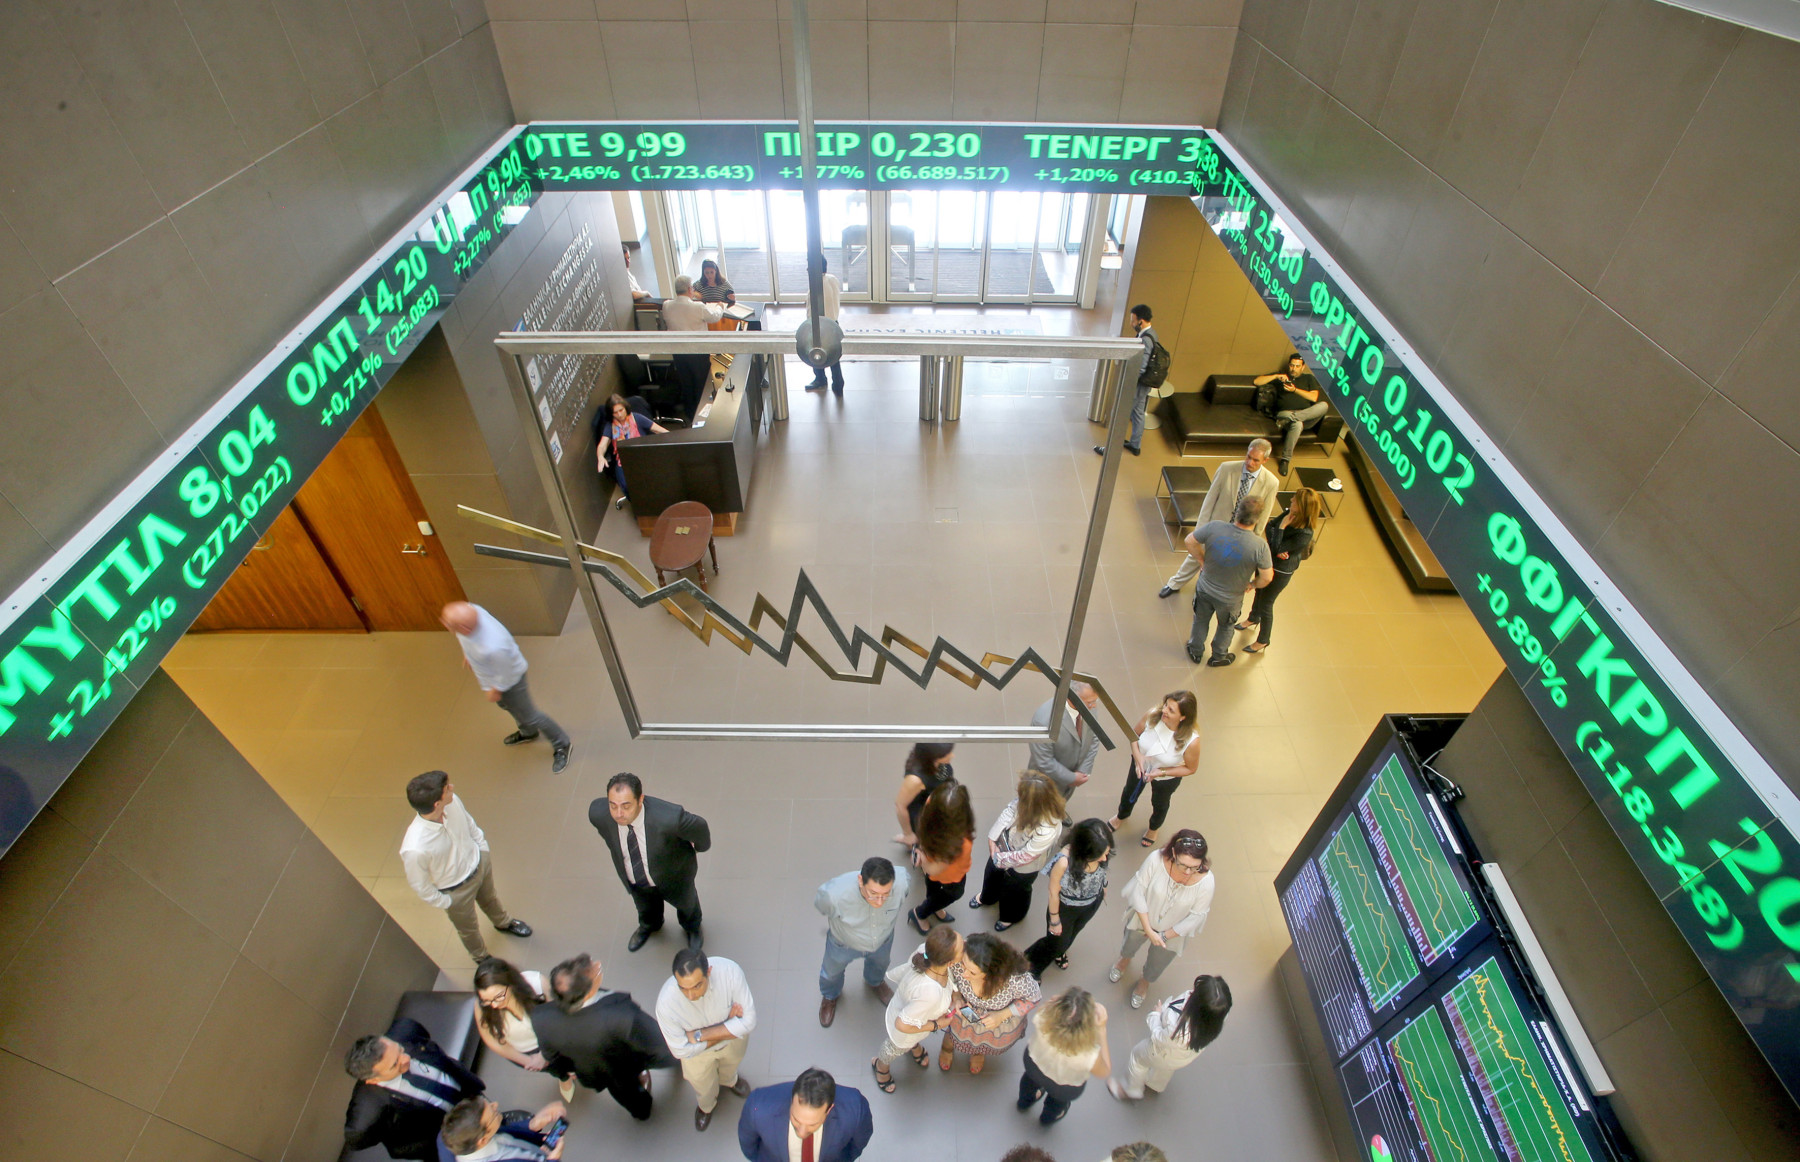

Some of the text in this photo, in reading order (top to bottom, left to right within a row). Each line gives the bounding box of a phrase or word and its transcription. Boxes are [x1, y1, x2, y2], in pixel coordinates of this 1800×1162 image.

[537, 165, 620, 183] +2,46%
[631, 164, 755, 182] (1.723.643)
[779, 165, 865, 179] +177%
[876, 165, 1010, 184] (66.689.517)
[1034, 168, 1119, 184] +1,20%
[600, 131, 686, 162] 9,99
[871, 132, 982, 162] 0,230
[1023, 134, 1171, 161] ΤΕΝΕΡΓ
[179, 404, 276, 519] 8,04
[286, 316, 360, 406] ΟΛΠ
[357, 246, 428, 334] 14,20
[487, 149, 521, 202] 9,90
[523, 281, 551, 325] ΕΛΛΗΝΙΚΑ
[1254, 210, 1304, 284] 25,60
[1309, 281, 1385, 386] ΦΡΙΓΟ
[1384, 375, 1476, 506] 0,102
[47, 596, 178, 741] +2,42%
[182, 456, 292, 589] (272.022)
[320, 351, 383, 427] +0,71%
[385, 284, 439, 356] (25.083)
[453, 226, 492, 275] +2,27%
[1250, 250, 1294, 320] (130.940)
[1305, 328, 1350, 397] +8,51%
[1353, 394, 1417, 490] (56.000)
[1476, 571, 1569, 709] +0,89%
[1575, 720, 1744, 951] (118.348)
